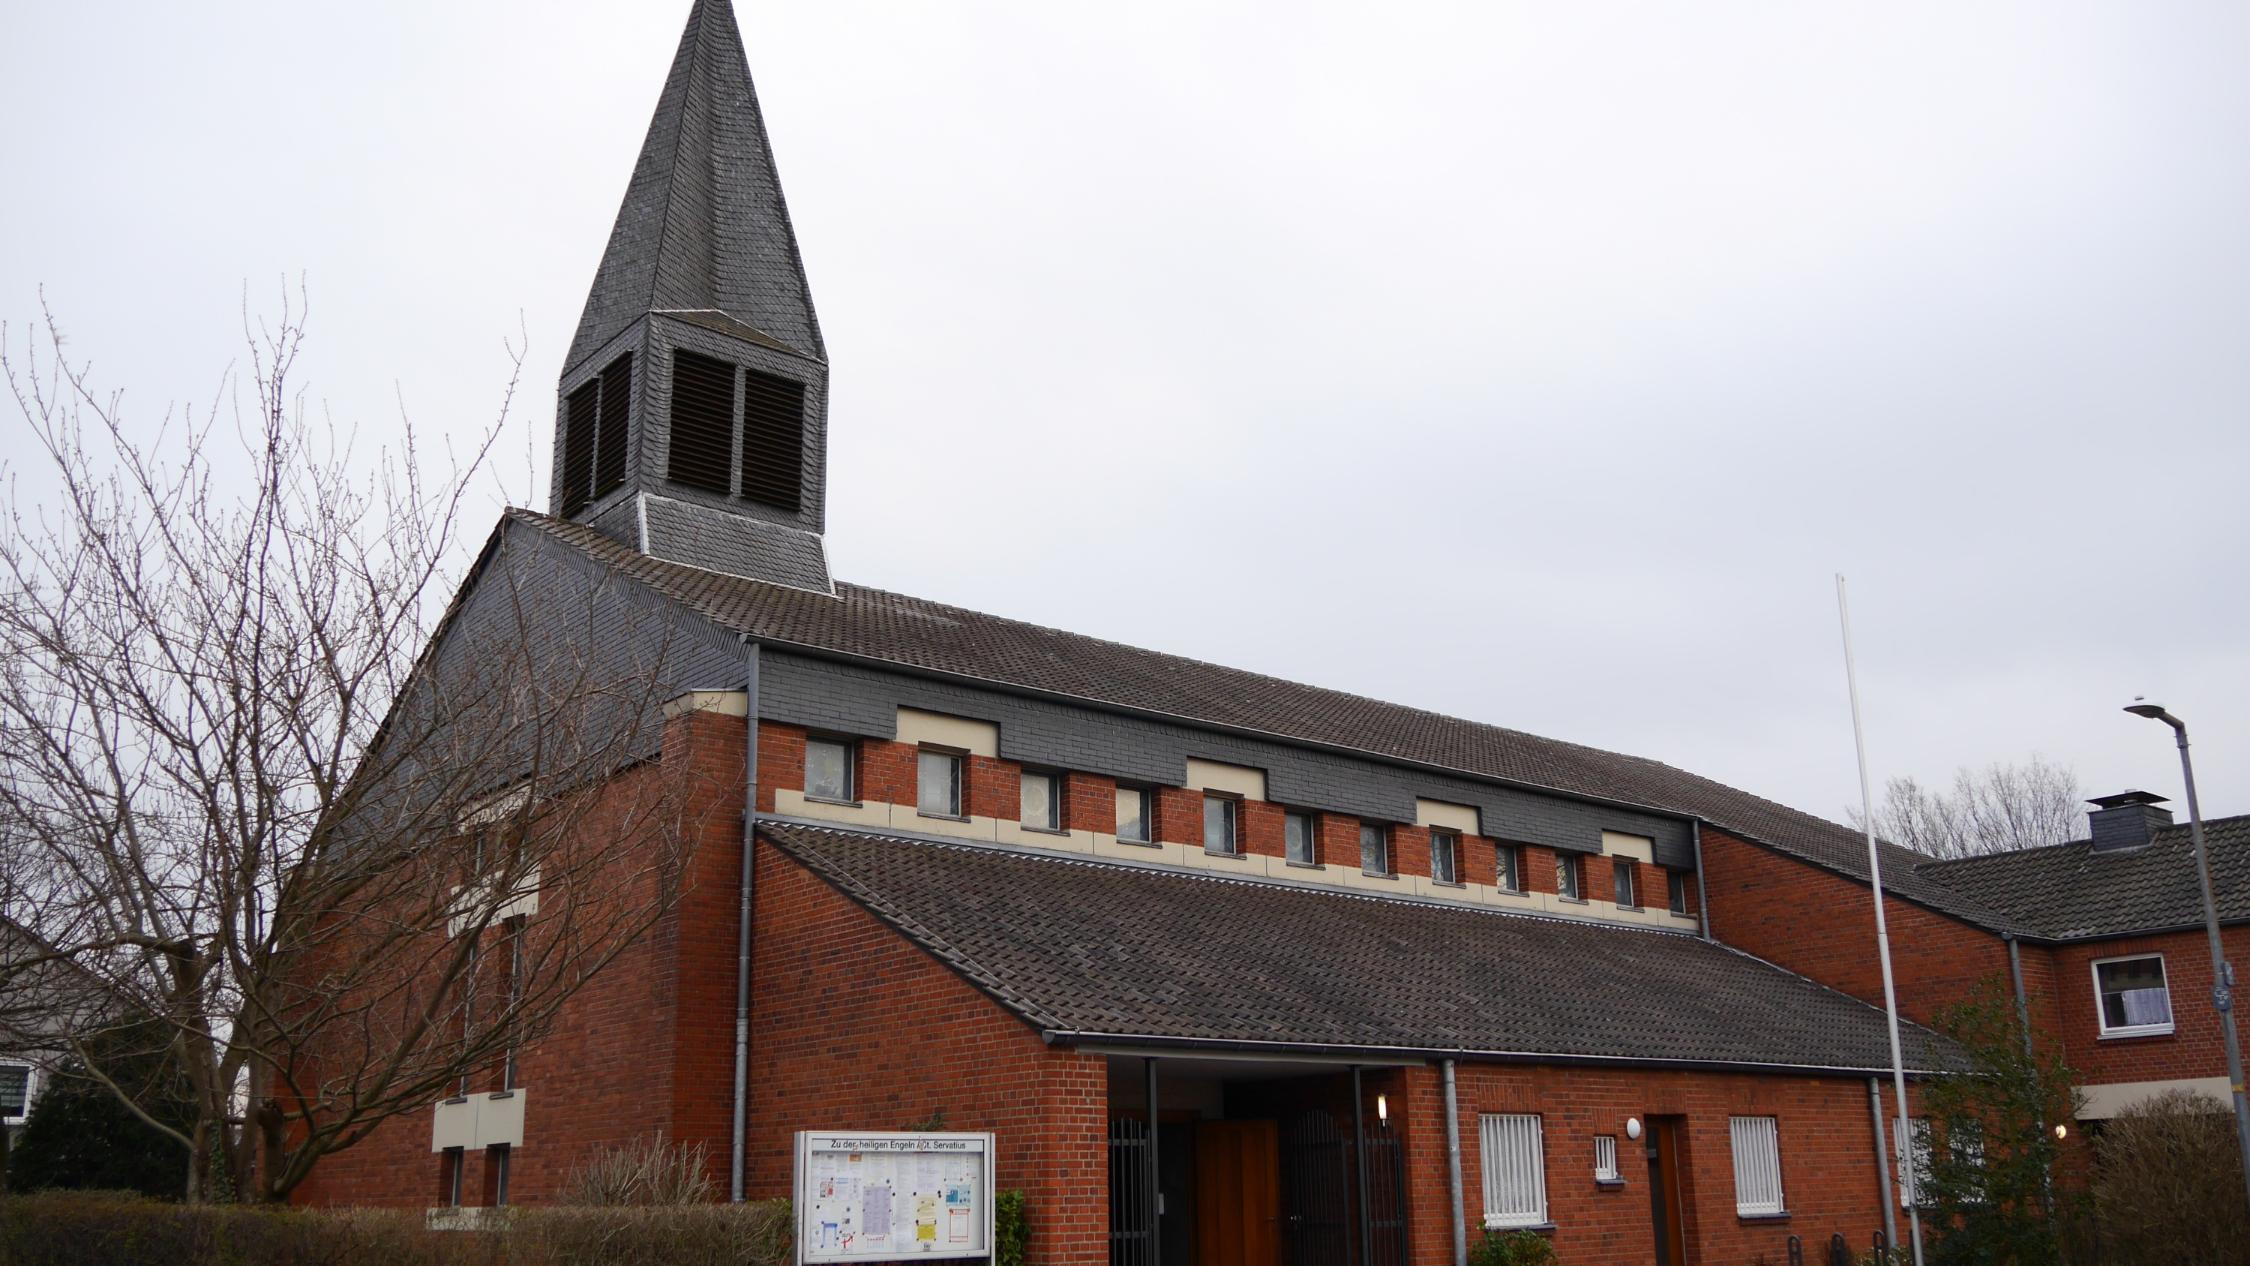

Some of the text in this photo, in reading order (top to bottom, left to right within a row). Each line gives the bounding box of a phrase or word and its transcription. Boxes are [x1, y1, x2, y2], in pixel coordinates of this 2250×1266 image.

[831, 1139, 841, 1148] Zu
[859, 1140, 888, 1150] heiligen
[890, 1140, 914, 1150] Engeln
[933, 1140, 966, 1149] Servatius
